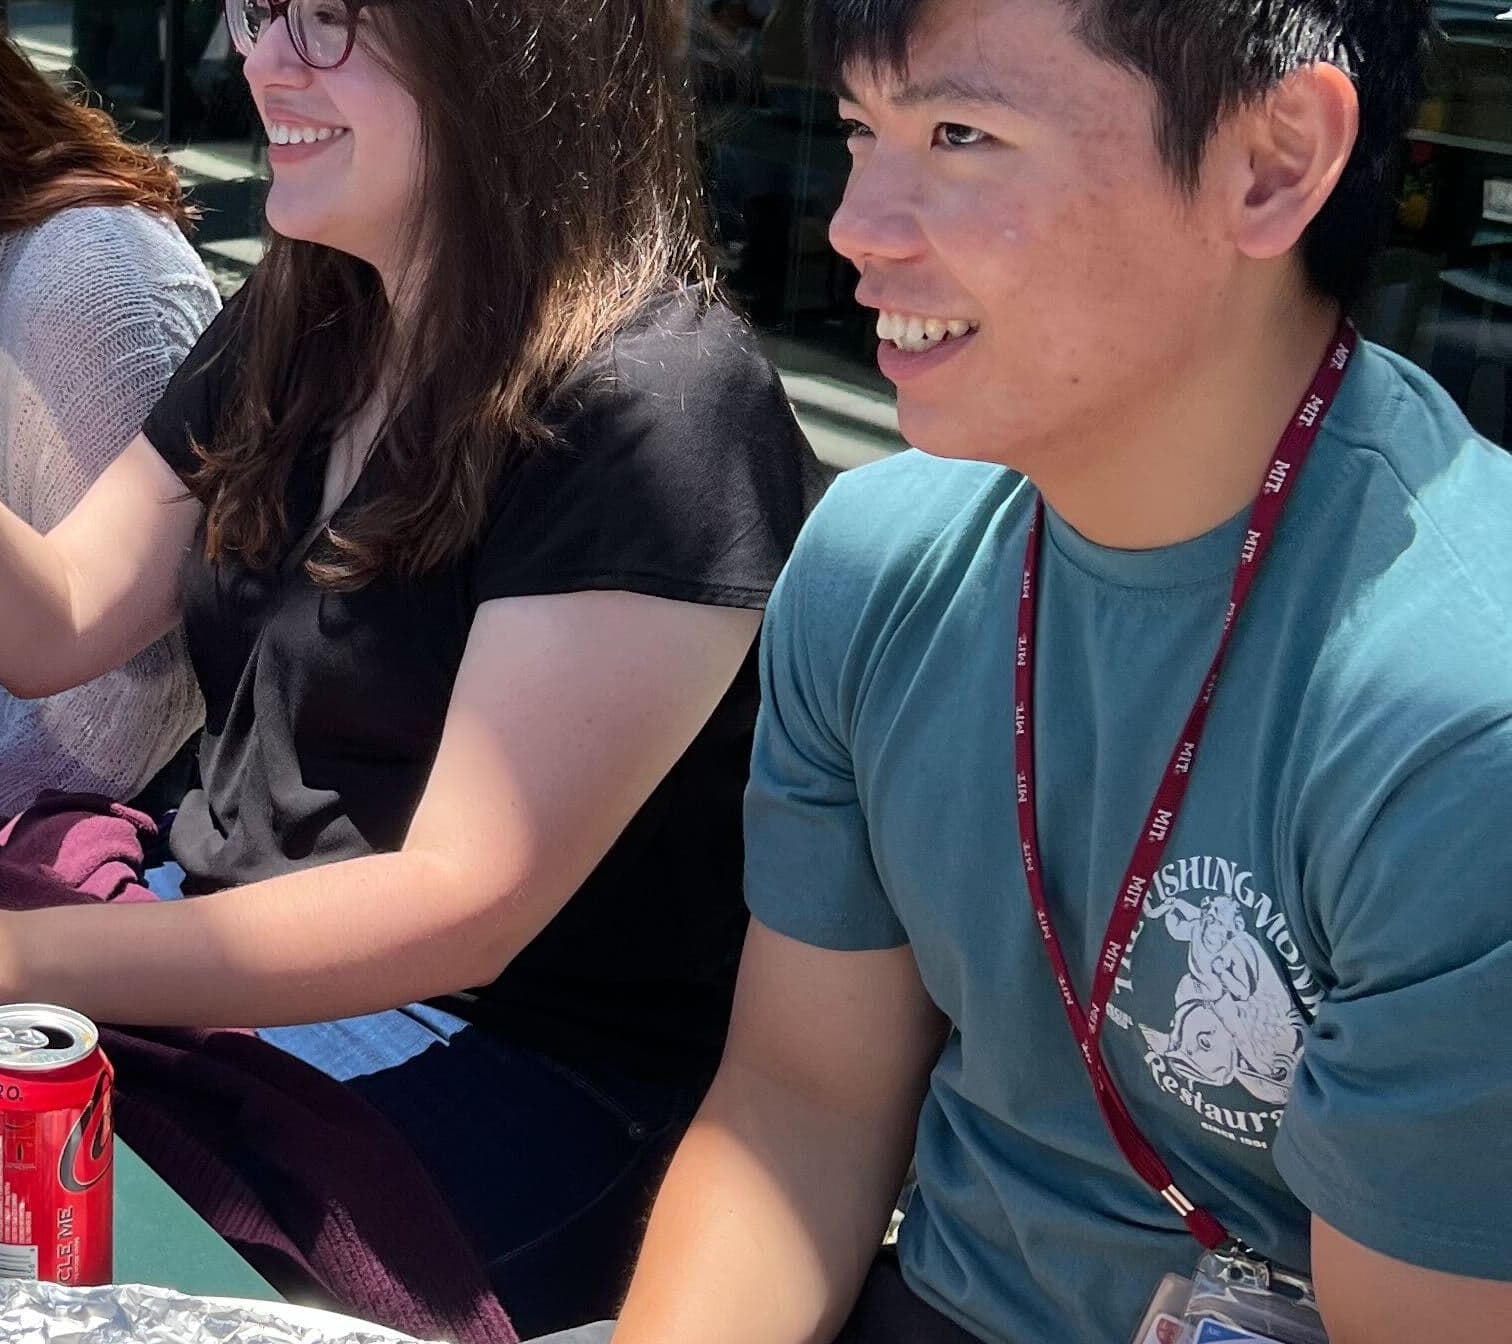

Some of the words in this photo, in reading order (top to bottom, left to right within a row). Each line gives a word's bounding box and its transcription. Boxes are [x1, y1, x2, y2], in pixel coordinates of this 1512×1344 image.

[1298, 394, 1325, 428] MIT
[1264, 459, 1291, 494] MIT
[1240, 529, 1262, 565] MIT
[1017, 632, 1029, 667] MIT
[1015, 700, 1026, 736] MIT
[1175, 742, 1195, 774] MIT
[1017, 771, 1028, 805] MIT
[1148, 808, 1172, 843] MIT
[1022, 840, 1034, 872] MIT
[1124, 875, 1147, 909] MIT
[1151, 855, 1254, 908] ISHING
[1036, 910, 1051, 941] MIT
[1103, 941, 1122, 974] MIT
[1144, 1051, 1286, 1133] Restaura
[57, 1205, 75, 1240] ME
